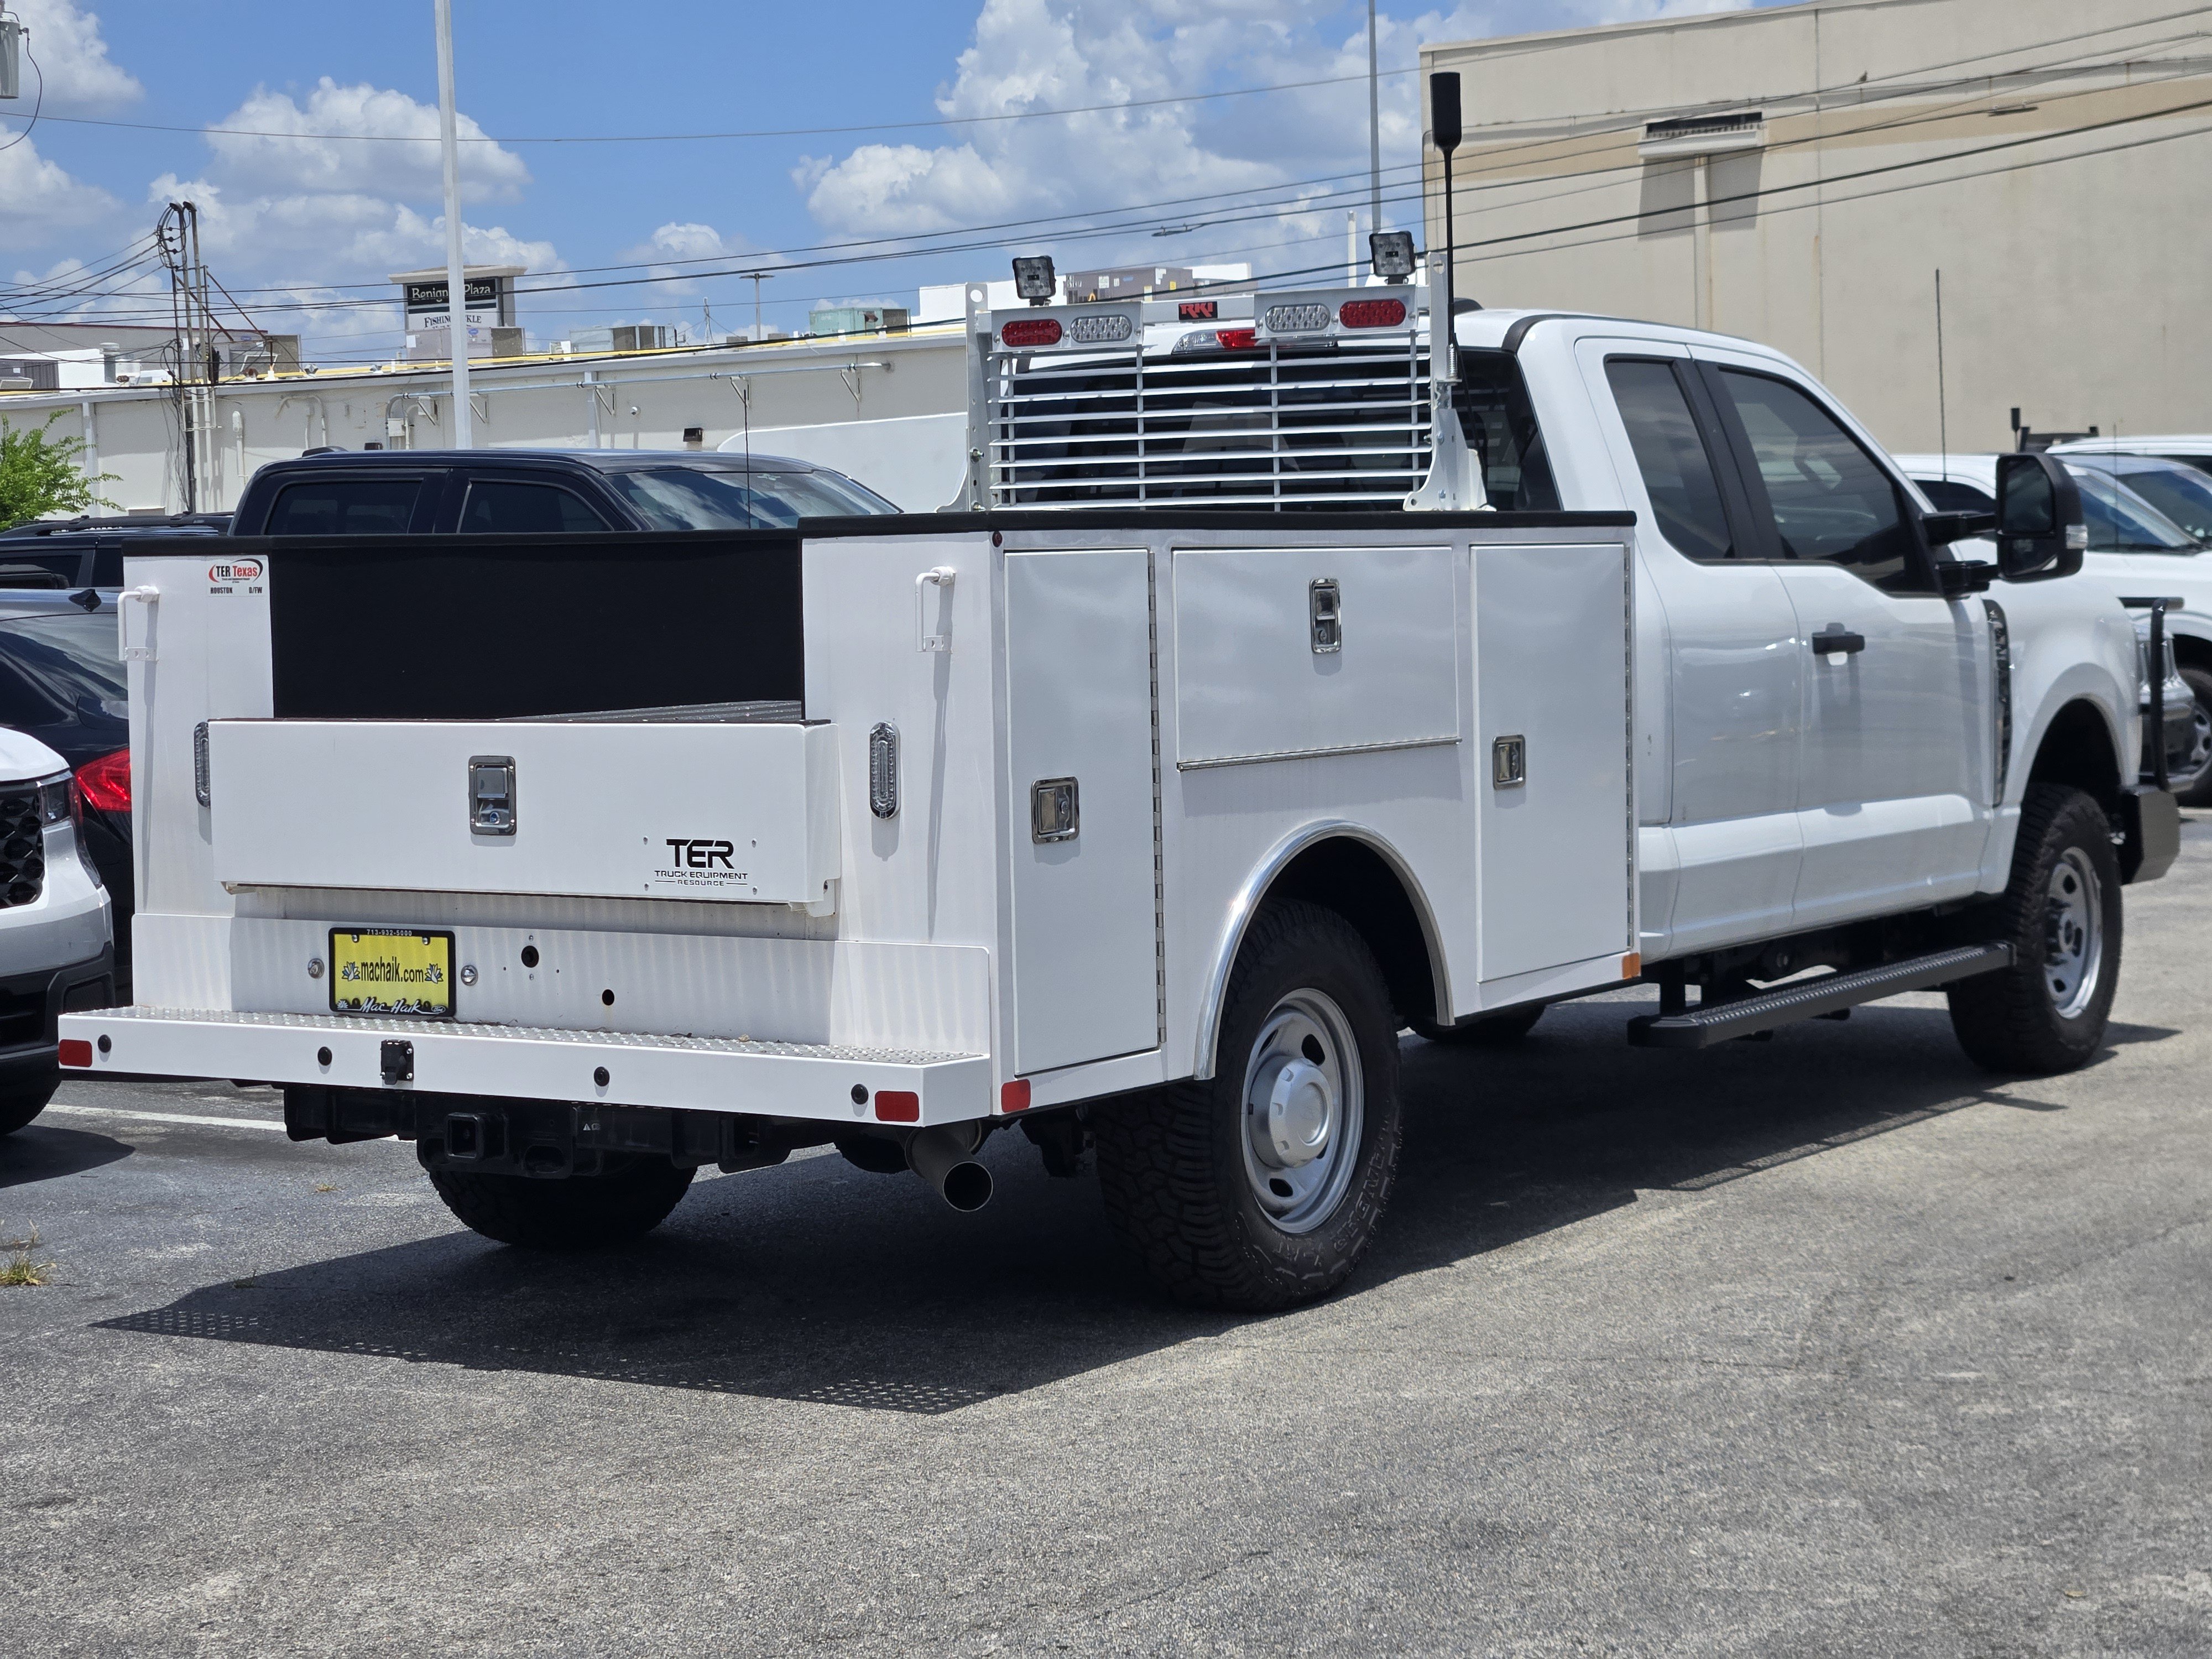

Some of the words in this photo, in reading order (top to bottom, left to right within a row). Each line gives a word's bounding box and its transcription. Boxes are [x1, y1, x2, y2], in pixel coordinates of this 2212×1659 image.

[411, 288, 448, 302] Benign
[1179, 302, 1213, 319] RKI
[424, 315, 451, 328] FISHIN
[216, 566, 231, 577] TER
[232, 566, 258, 577] Texas
[666, 839, 734, 869] TER
[361, 956, 424, 983] machaik.com
[360, 997, 389, 1013] Mac
[390, 999, 421, 1014] Haik
